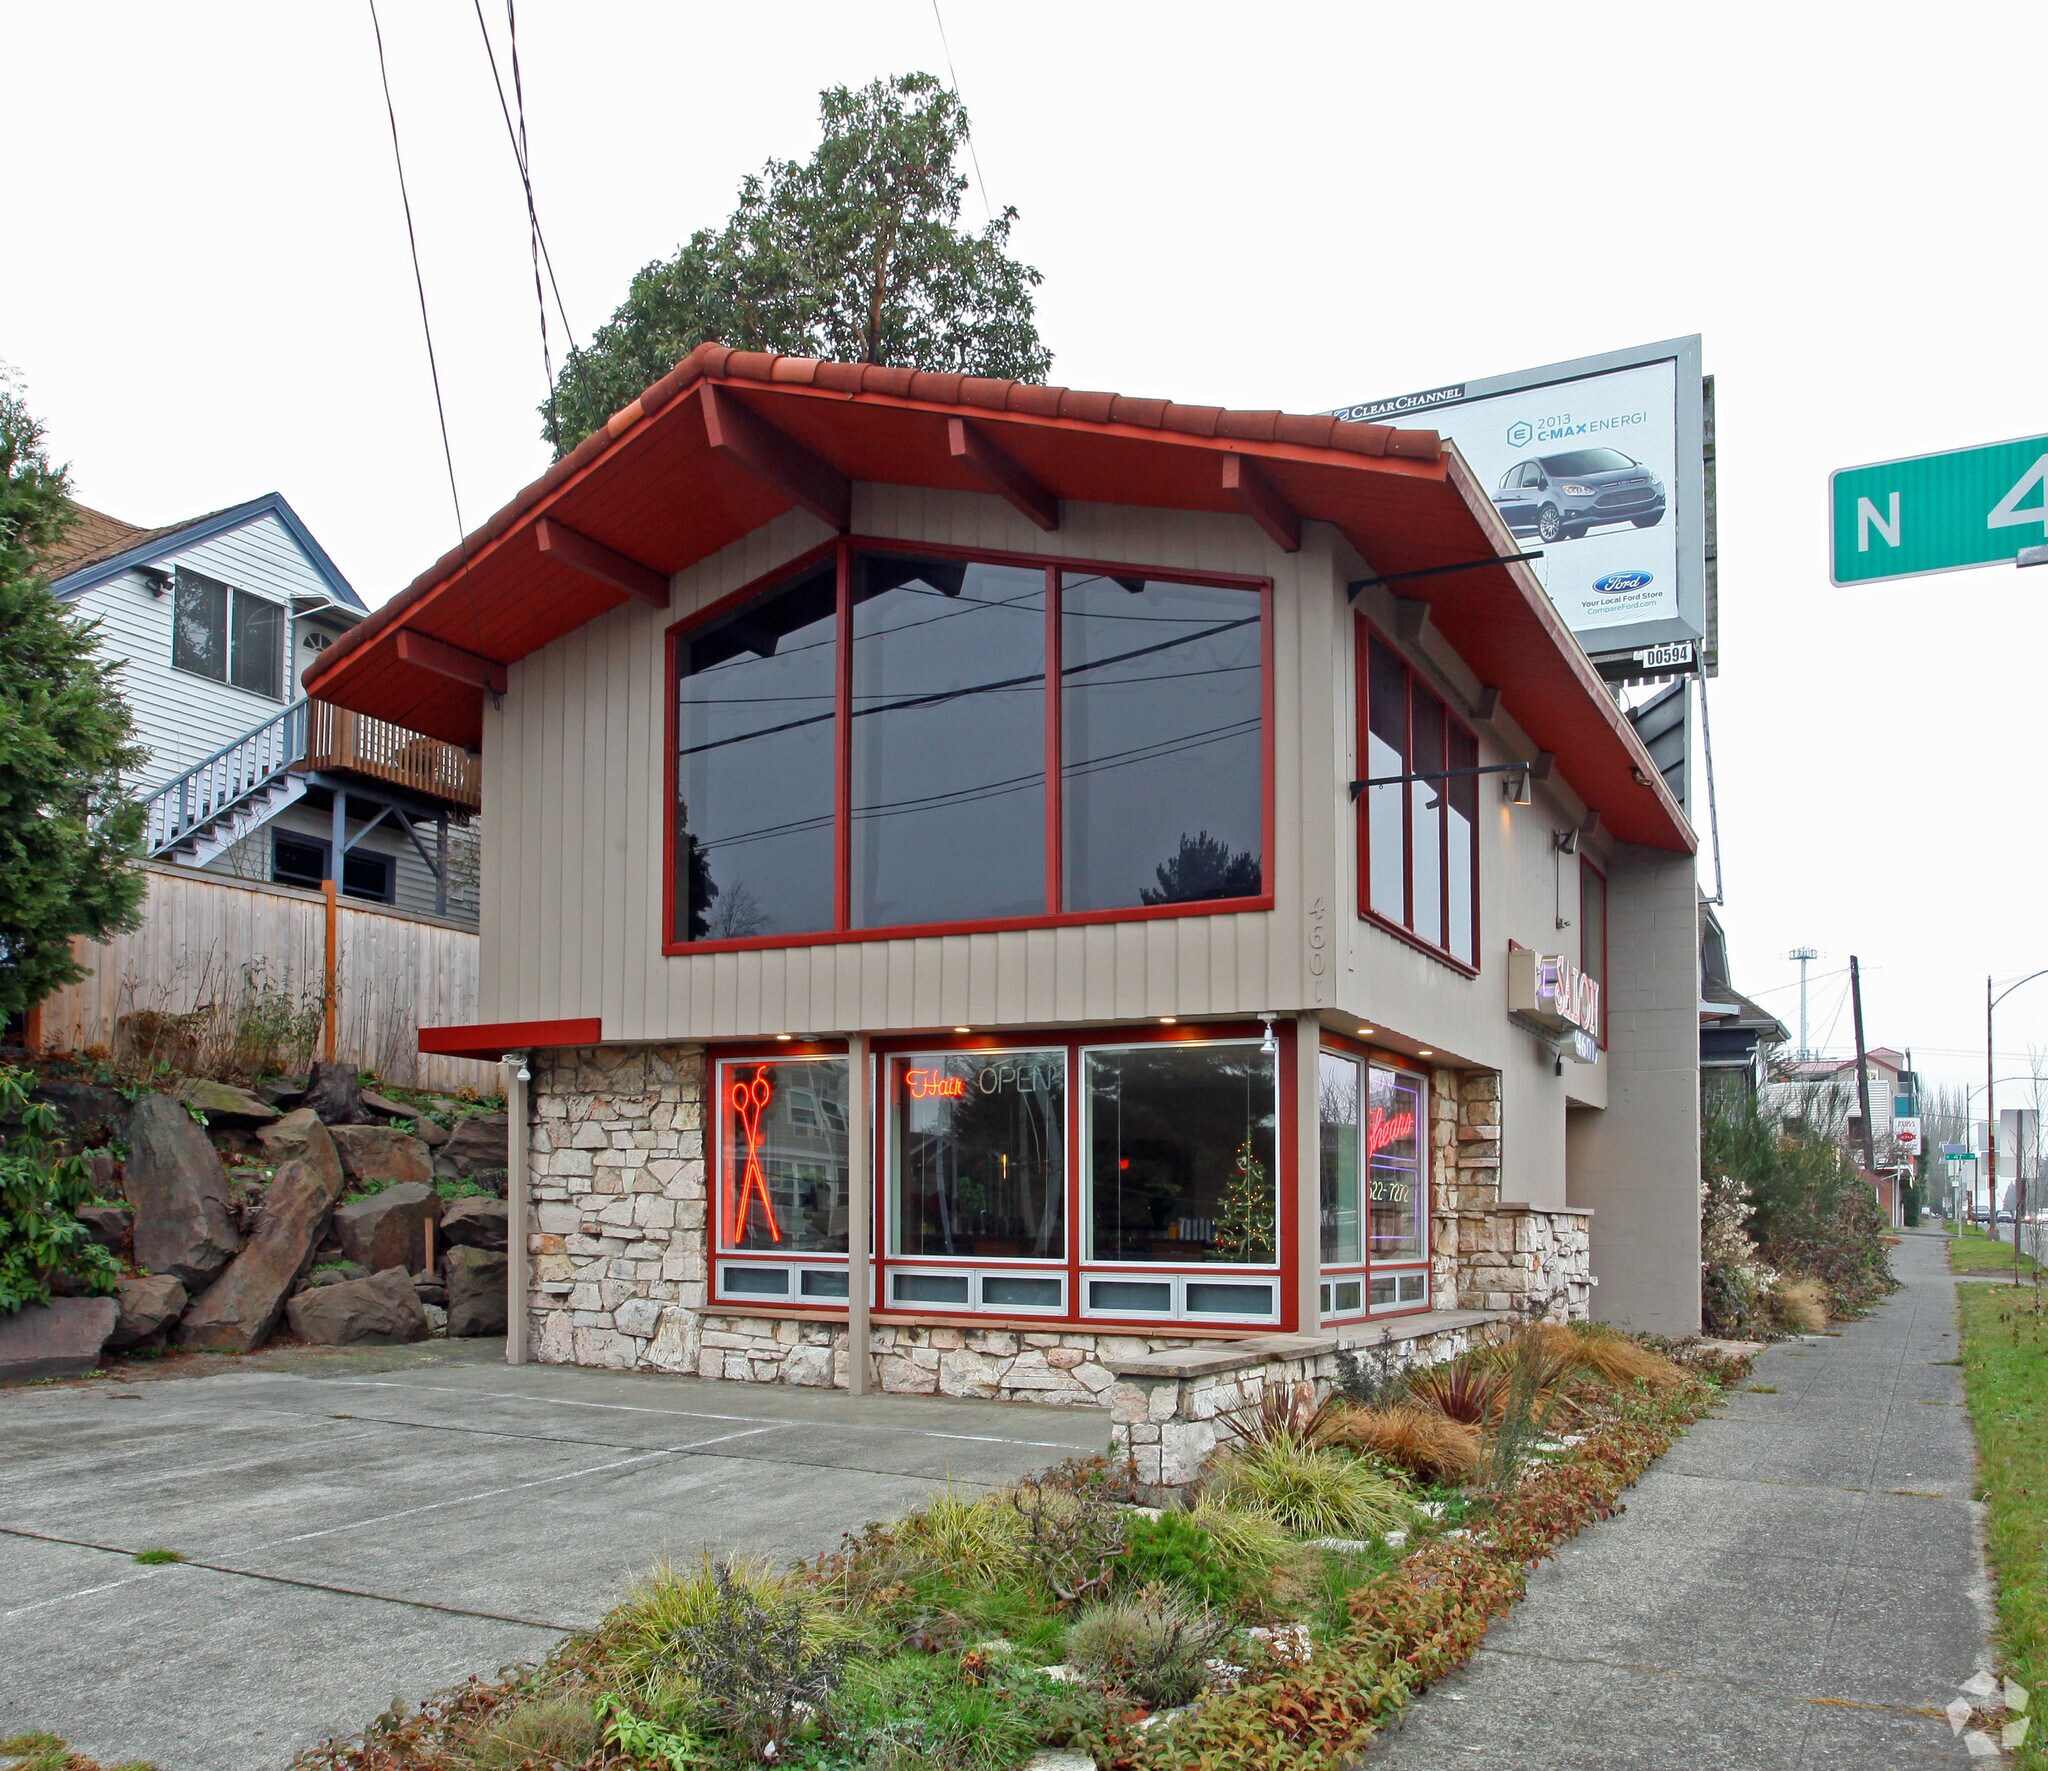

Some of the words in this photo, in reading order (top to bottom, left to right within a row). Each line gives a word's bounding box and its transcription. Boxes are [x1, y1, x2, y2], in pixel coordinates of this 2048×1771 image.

[1537, 413, 1571, 429] 2013
[1537, 423, 1587, 441] C-MAX
[1590, 411, 1647, 432] ENERGI
[1858, 491, 1900, 552] N
[1604, 574, 1641, 591] Ford
[1581, 599, 1599, 608] Your
[1601, 596, 1621, 606] Local
[1623, 593, 1640, 602] Ford
[1642, 591, 1663, 600] Store
[1587, 600, 1657, 615] CompareFord.com
[1647, 645, 1687, 665] 00594
[1309, 896, 1326, 1003] 4601
[1555, 955, 1599, 1038] SALON
[906, 1069, 963, 1098] Hair
[979, 1065, 1051, 1094] OPEN
